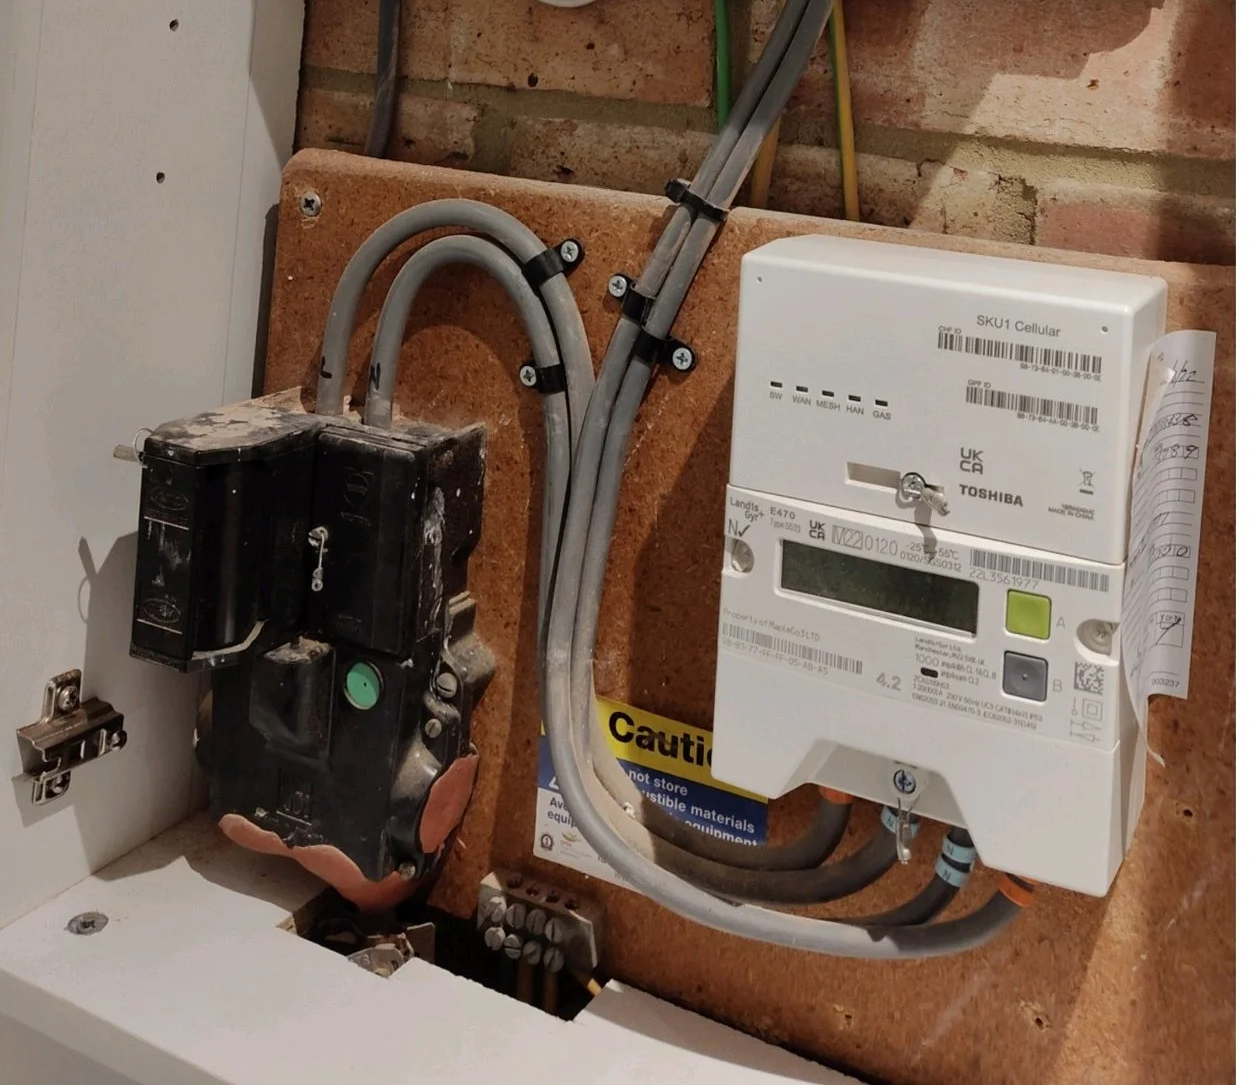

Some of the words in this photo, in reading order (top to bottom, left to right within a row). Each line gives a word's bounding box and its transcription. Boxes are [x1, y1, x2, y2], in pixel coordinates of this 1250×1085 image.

[976, 314, 1010, 330] SKU1
[1014, 320, 1061, 337] Cellular
[769, 391, 783, 400] SW
[792, 395, 811, 406] WAN
[816, 399, 841, 411] MESH
[846, 405, 864, 415] HAN
[872, 409, 891, 420] GAS
[959, 483, 1023, 507] TOSHIBA
[968, 567, 1039, 589] 22L3561977
[609, 711, 713, 766] Cauti
[629, 768, 650, 784] not
[653, 777, 689, 796] store
[690, 804, 756, 835] materials
